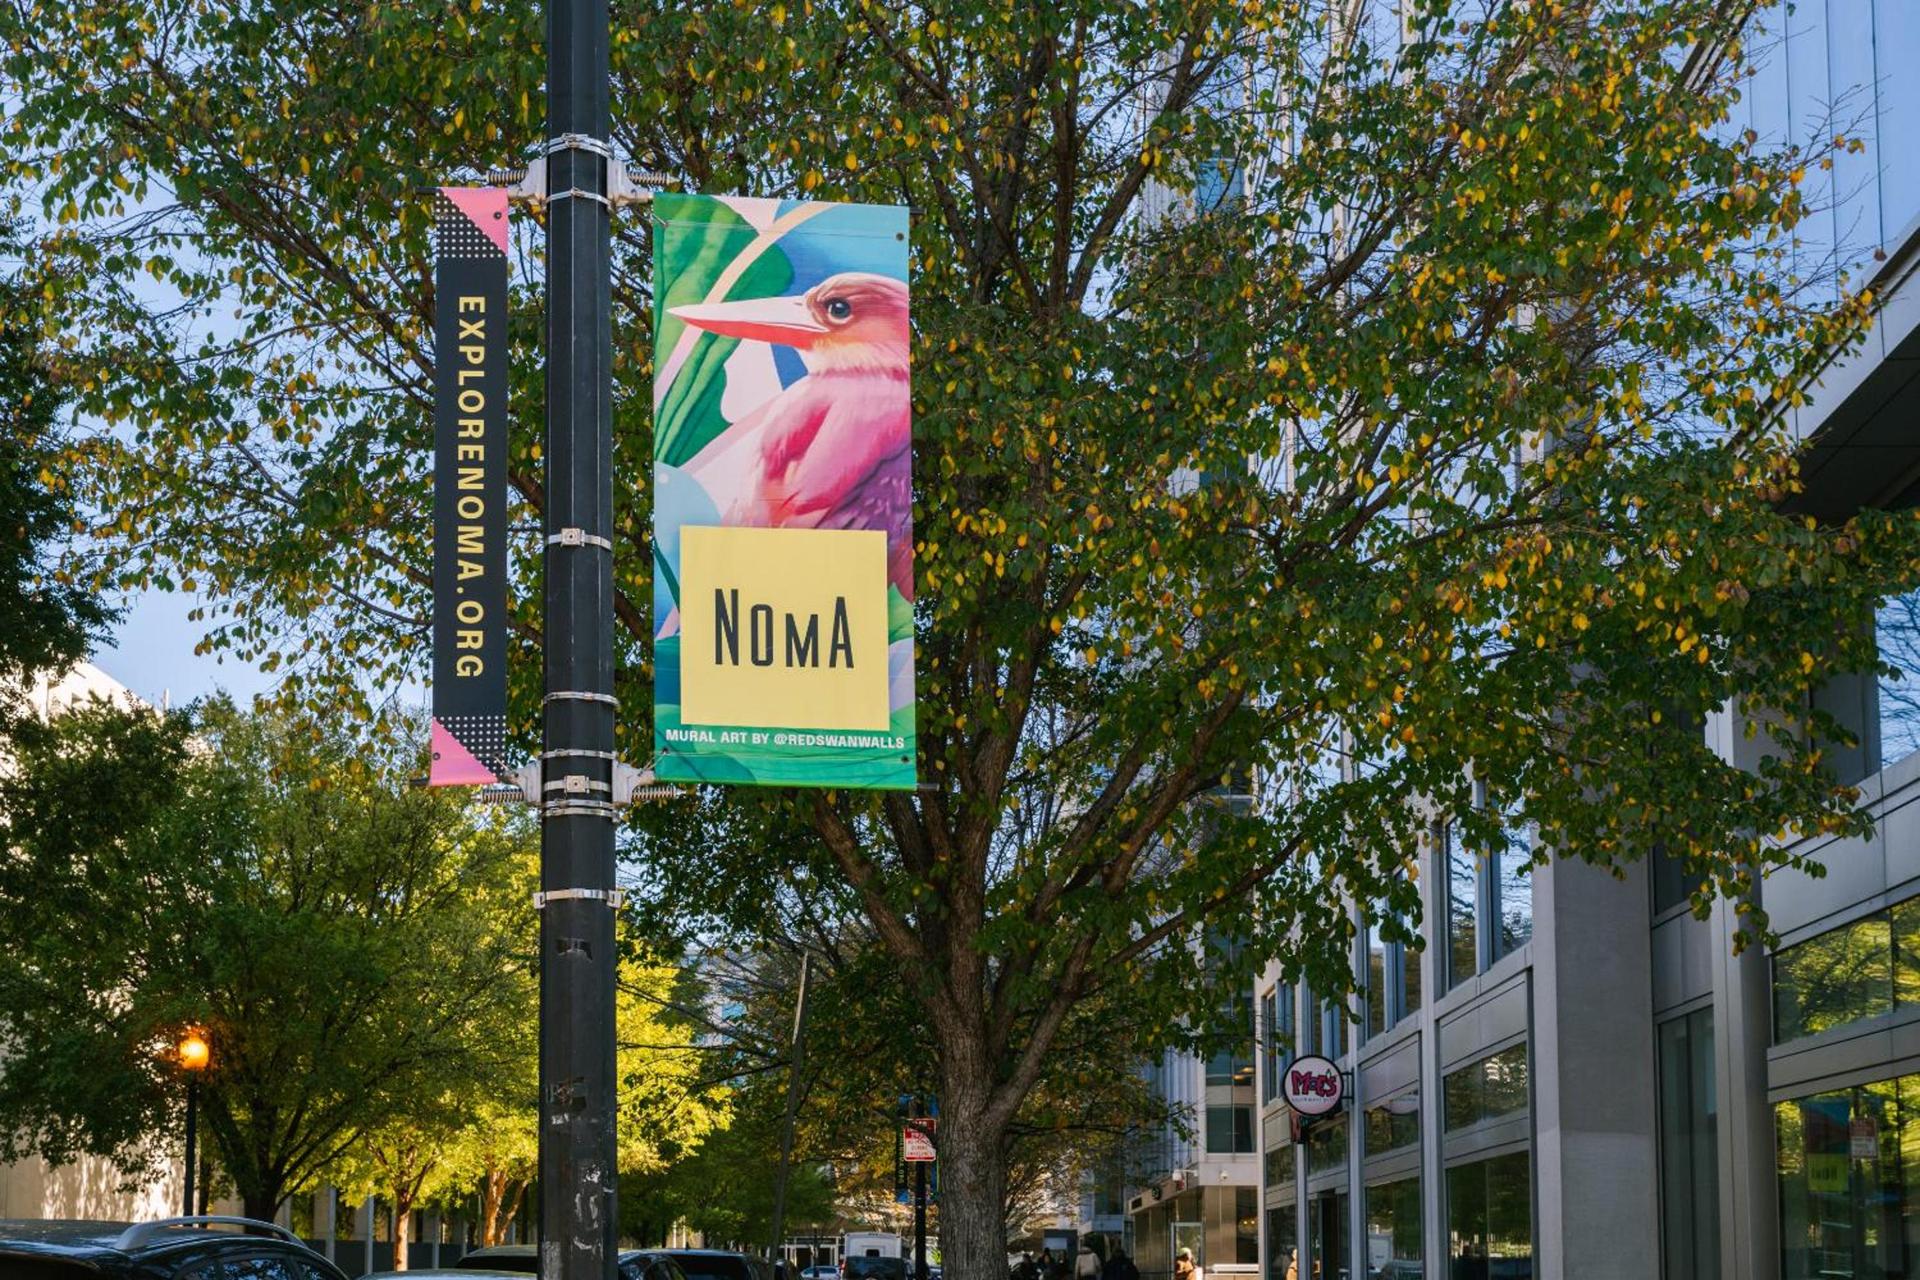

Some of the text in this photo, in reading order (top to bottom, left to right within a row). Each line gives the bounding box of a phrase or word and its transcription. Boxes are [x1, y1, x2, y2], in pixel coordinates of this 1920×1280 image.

[456, 296, 486, 677] EXPLORENOMA.ORG
[665, 729, 905, 749] MURAL ART BY @REDSWANWALLS
